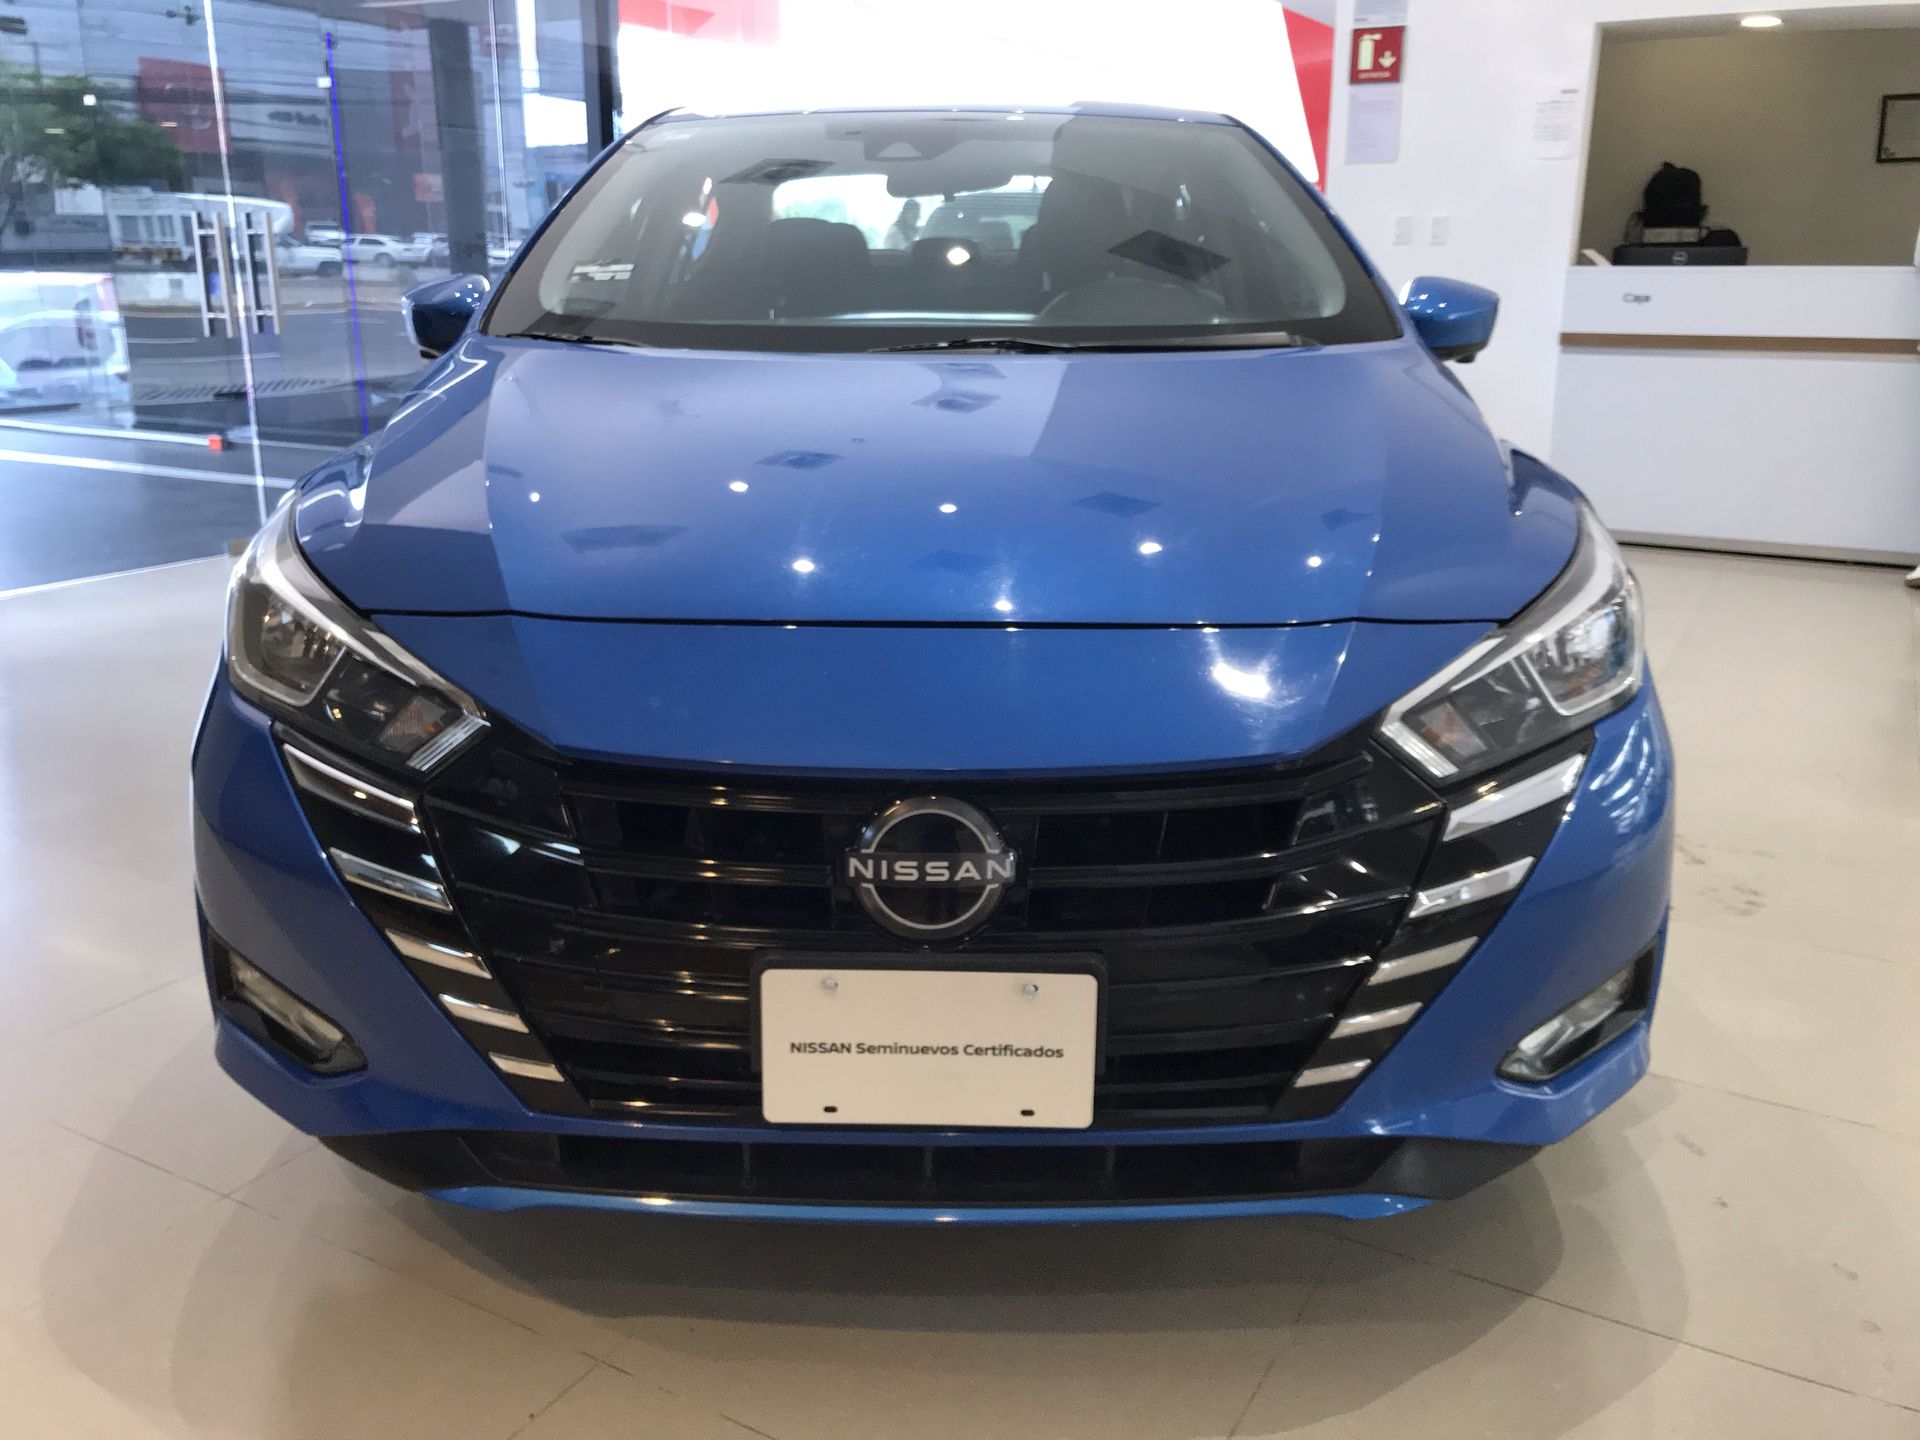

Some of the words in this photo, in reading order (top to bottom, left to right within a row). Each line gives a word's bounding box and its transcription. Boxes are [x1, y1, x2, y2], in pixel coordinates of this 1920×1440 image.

[848, 857, 1015, 882] NISSAN
[790, 1042, 852, 1054] NISSAN
[856, 1042, 960, 1056] Seminuevos
[963, 1044, 1065, 1059] Certificados
